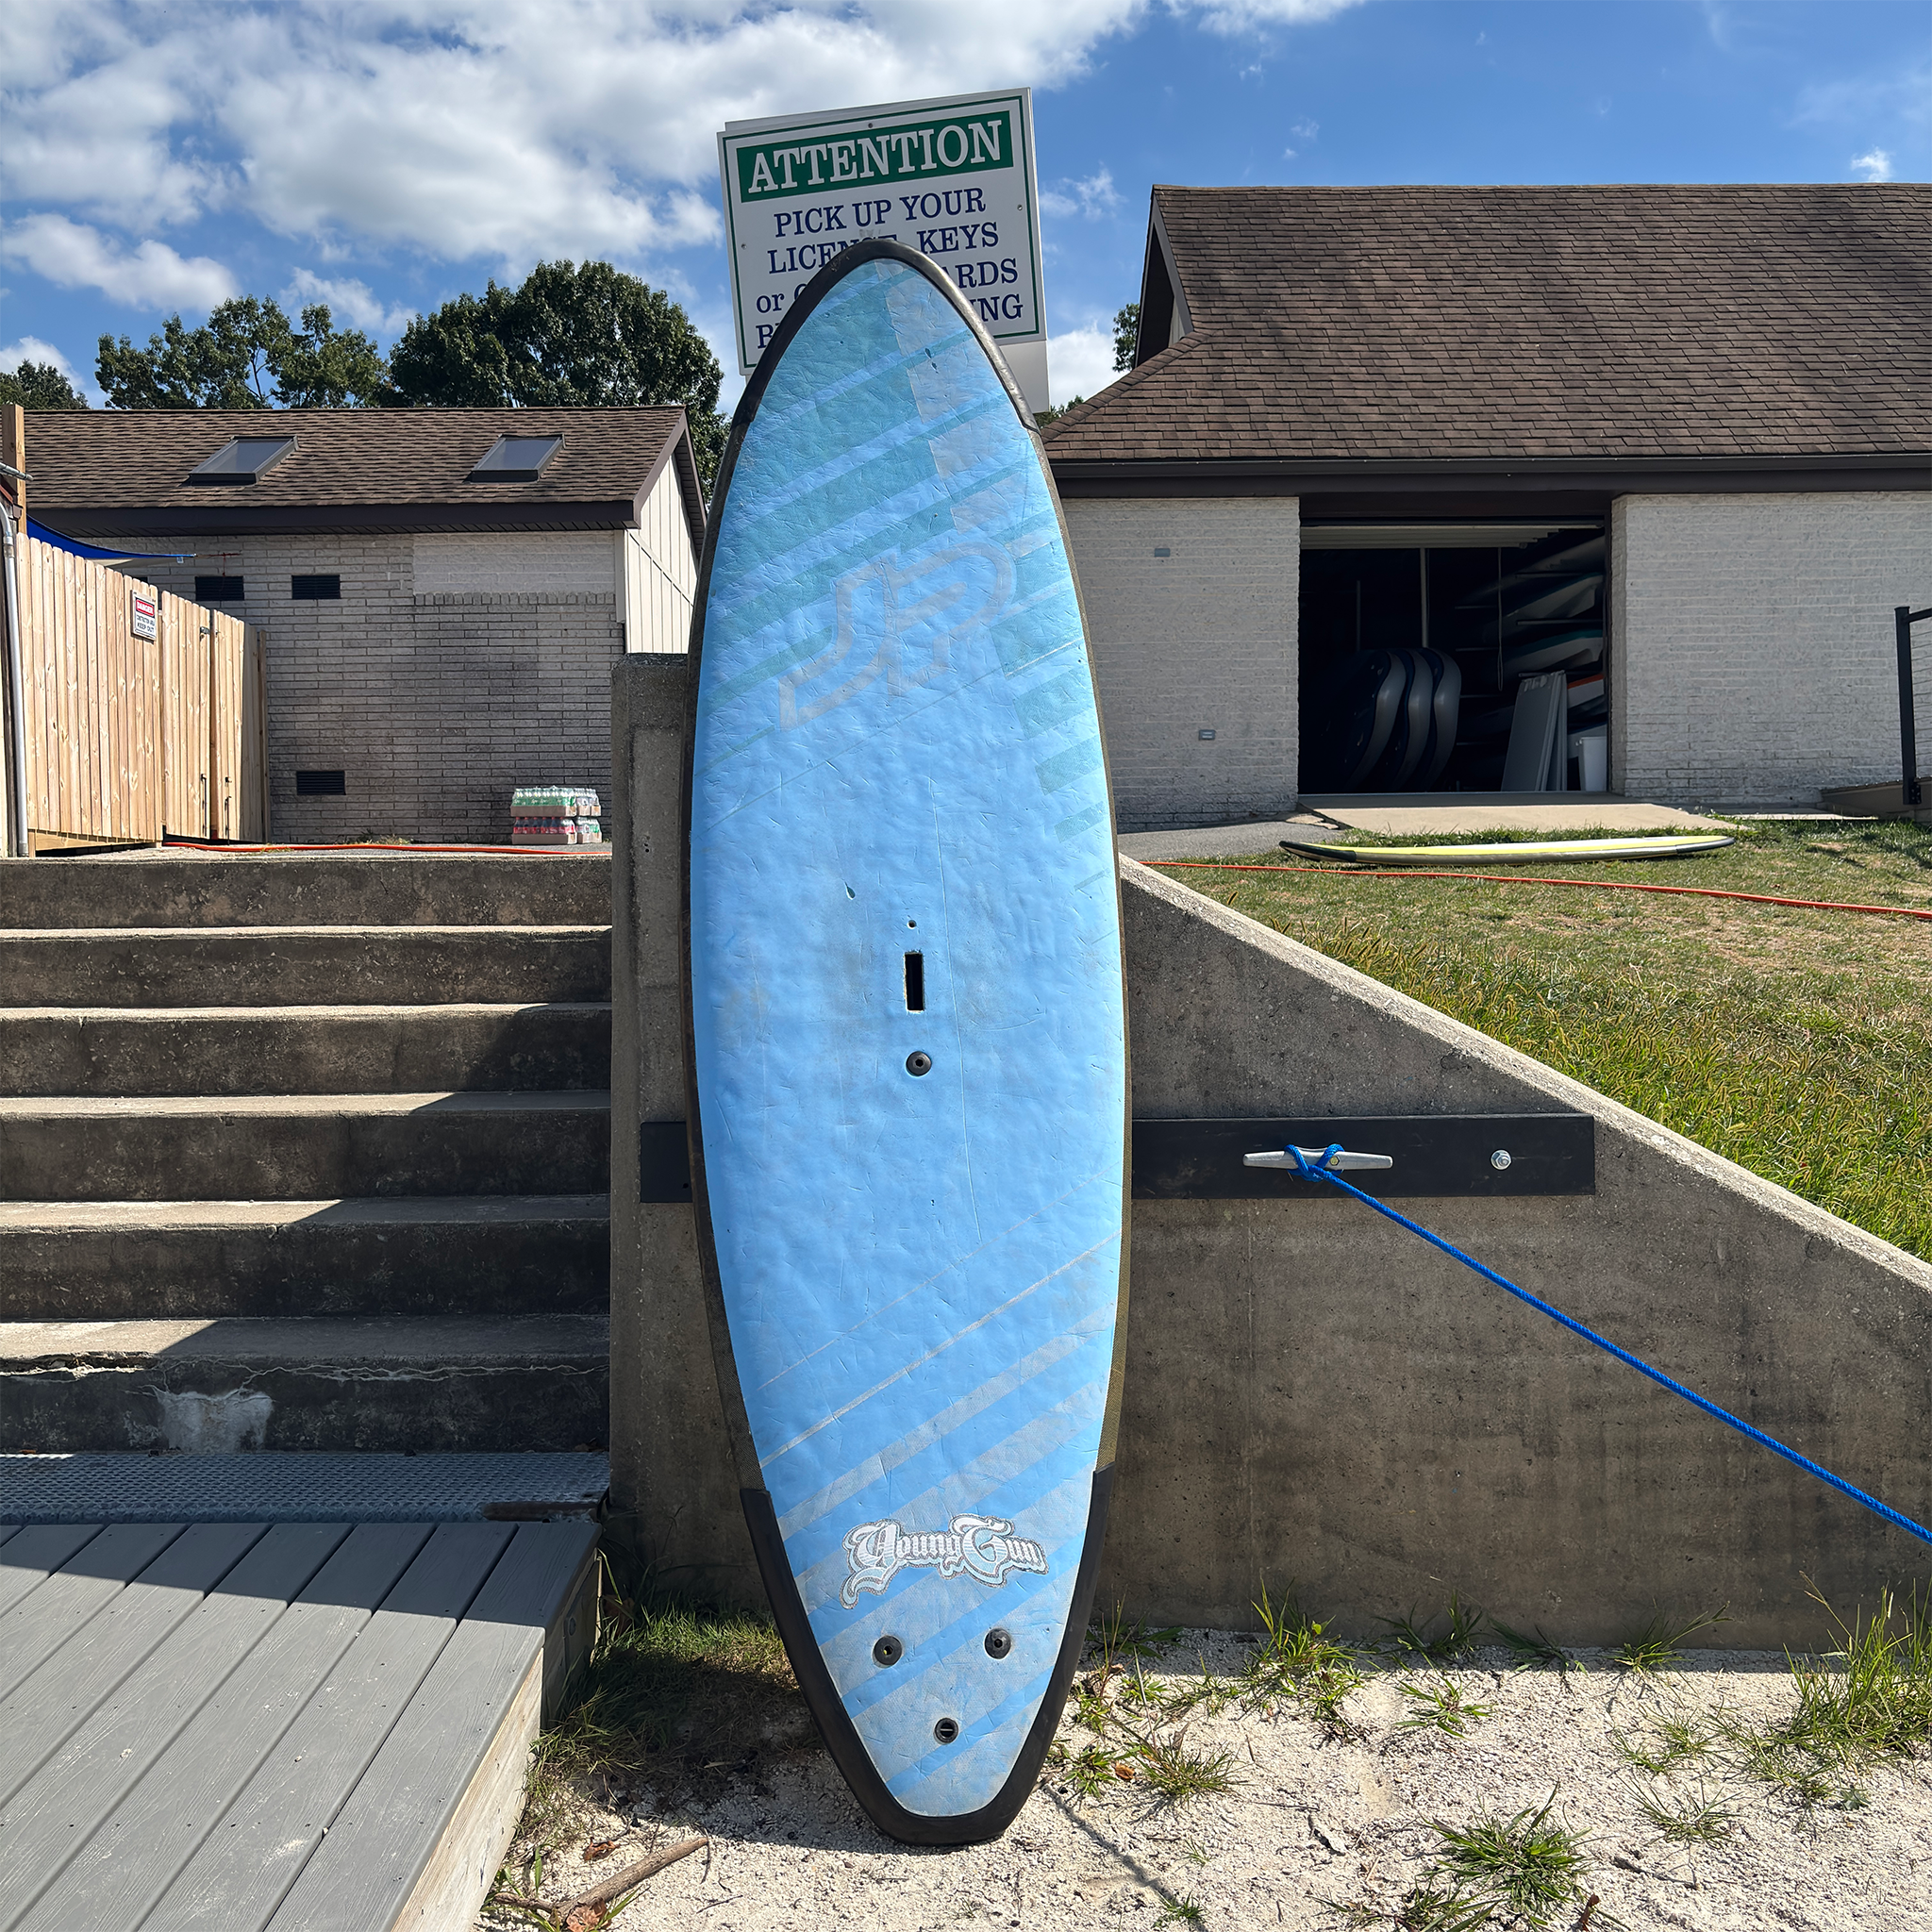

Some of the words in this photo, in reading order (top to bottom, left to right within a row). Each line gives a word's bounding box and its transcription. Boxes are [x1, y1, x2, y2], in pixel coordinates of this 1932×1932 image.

[748, 119, 1002, 193] ATTENTION
[774, 205, 847, 238] PICK
[852, 199, 891, 227] UP
[899, 188, 986, 221] YOUR
[767, 235, 897, 275] LICE
[916, 222, 999, 255] KEYS
[756, 291, 785, 313] or
